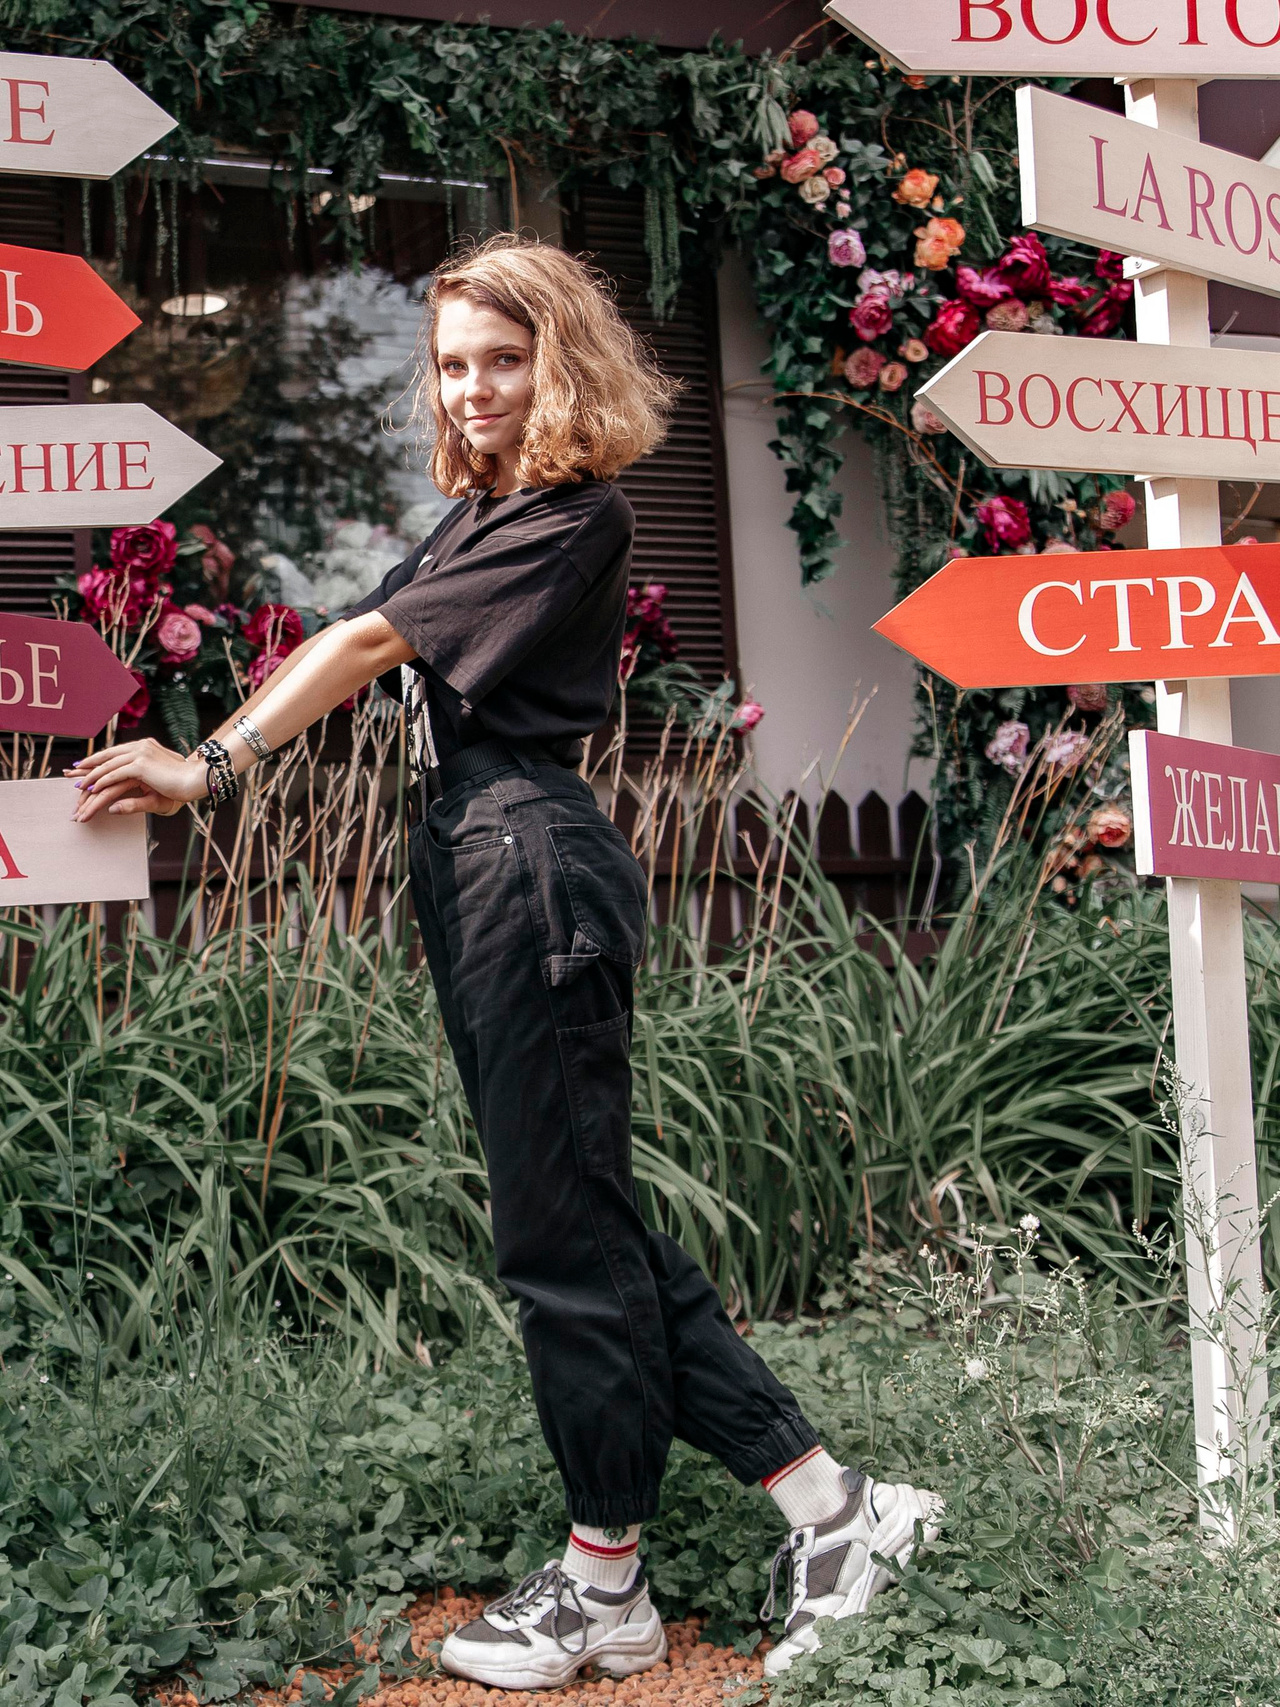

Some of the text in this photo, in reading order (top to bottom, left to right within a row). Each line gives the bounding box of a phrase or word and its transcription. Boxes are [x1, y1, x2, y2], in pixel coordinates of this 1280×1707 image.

[1089, 135, 1174, 232] LA
[1017, 571, 1280, 657] СТРА
[1164, 764, 1280, 856] ЖЕЛА
